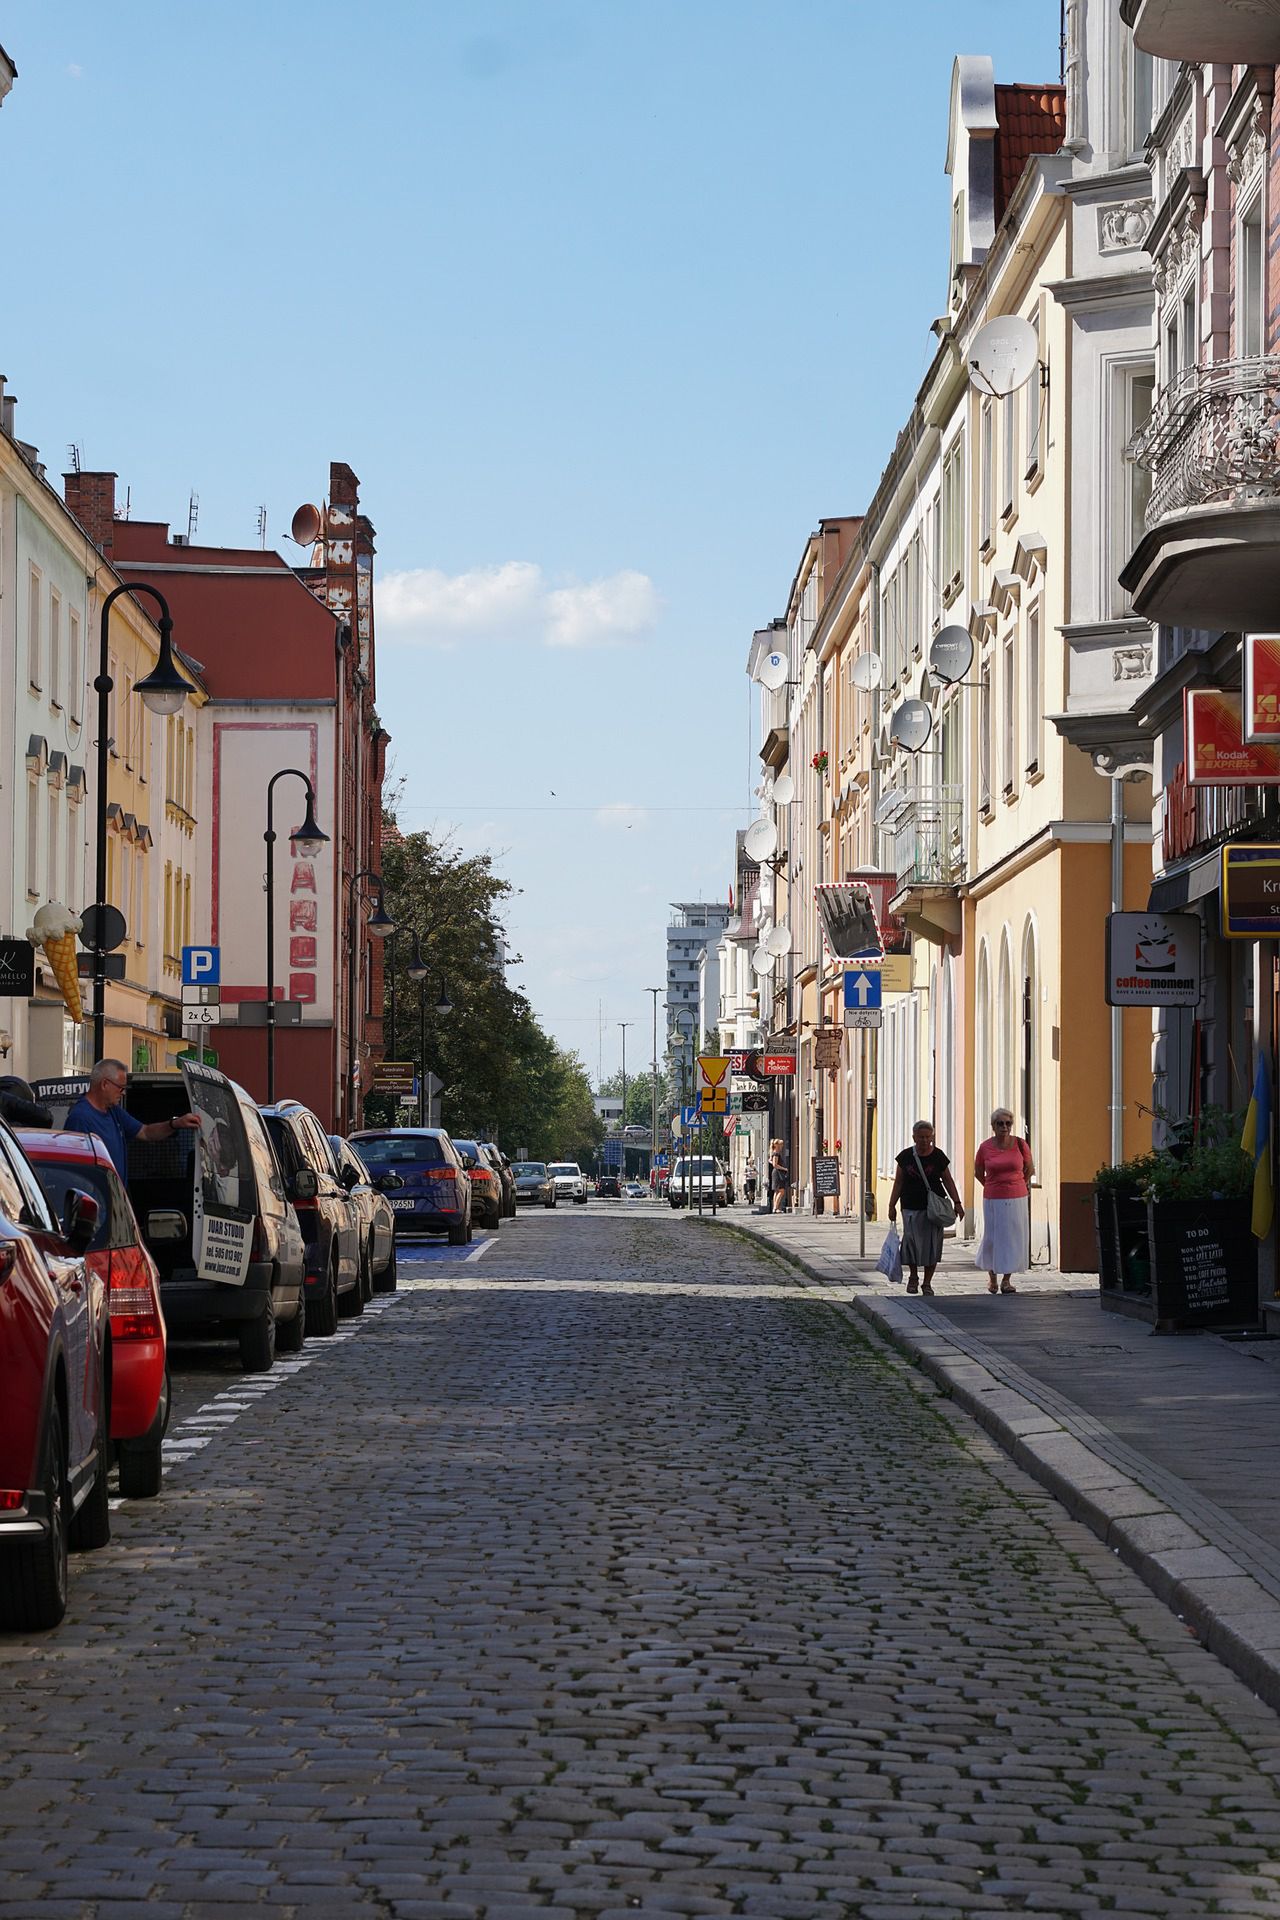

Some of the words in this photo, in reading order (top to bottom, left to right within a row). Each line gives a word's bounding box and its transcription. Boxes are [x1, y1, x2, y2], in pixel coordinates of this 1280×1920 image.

[1216, 751, 1249, 759] Kodak
[1206, 760, 1258, 769] EXPRESS
[191, 951, 213, 980] P
[1116, 976, 1195, 990] coffeemoment
[188, 1012, 199, 1020] 2x
[208, 1219, 223, 1234] JUAR
[224, 1222, 245, 1240] STUDIO
[1186, 1230, 1197, 1238] TO
[1198, 1228, 1209, 1237] DO
[206, 1246, 216, 1257] tel.
[204, 1261, 241, 1277] www.juar.com.pl
